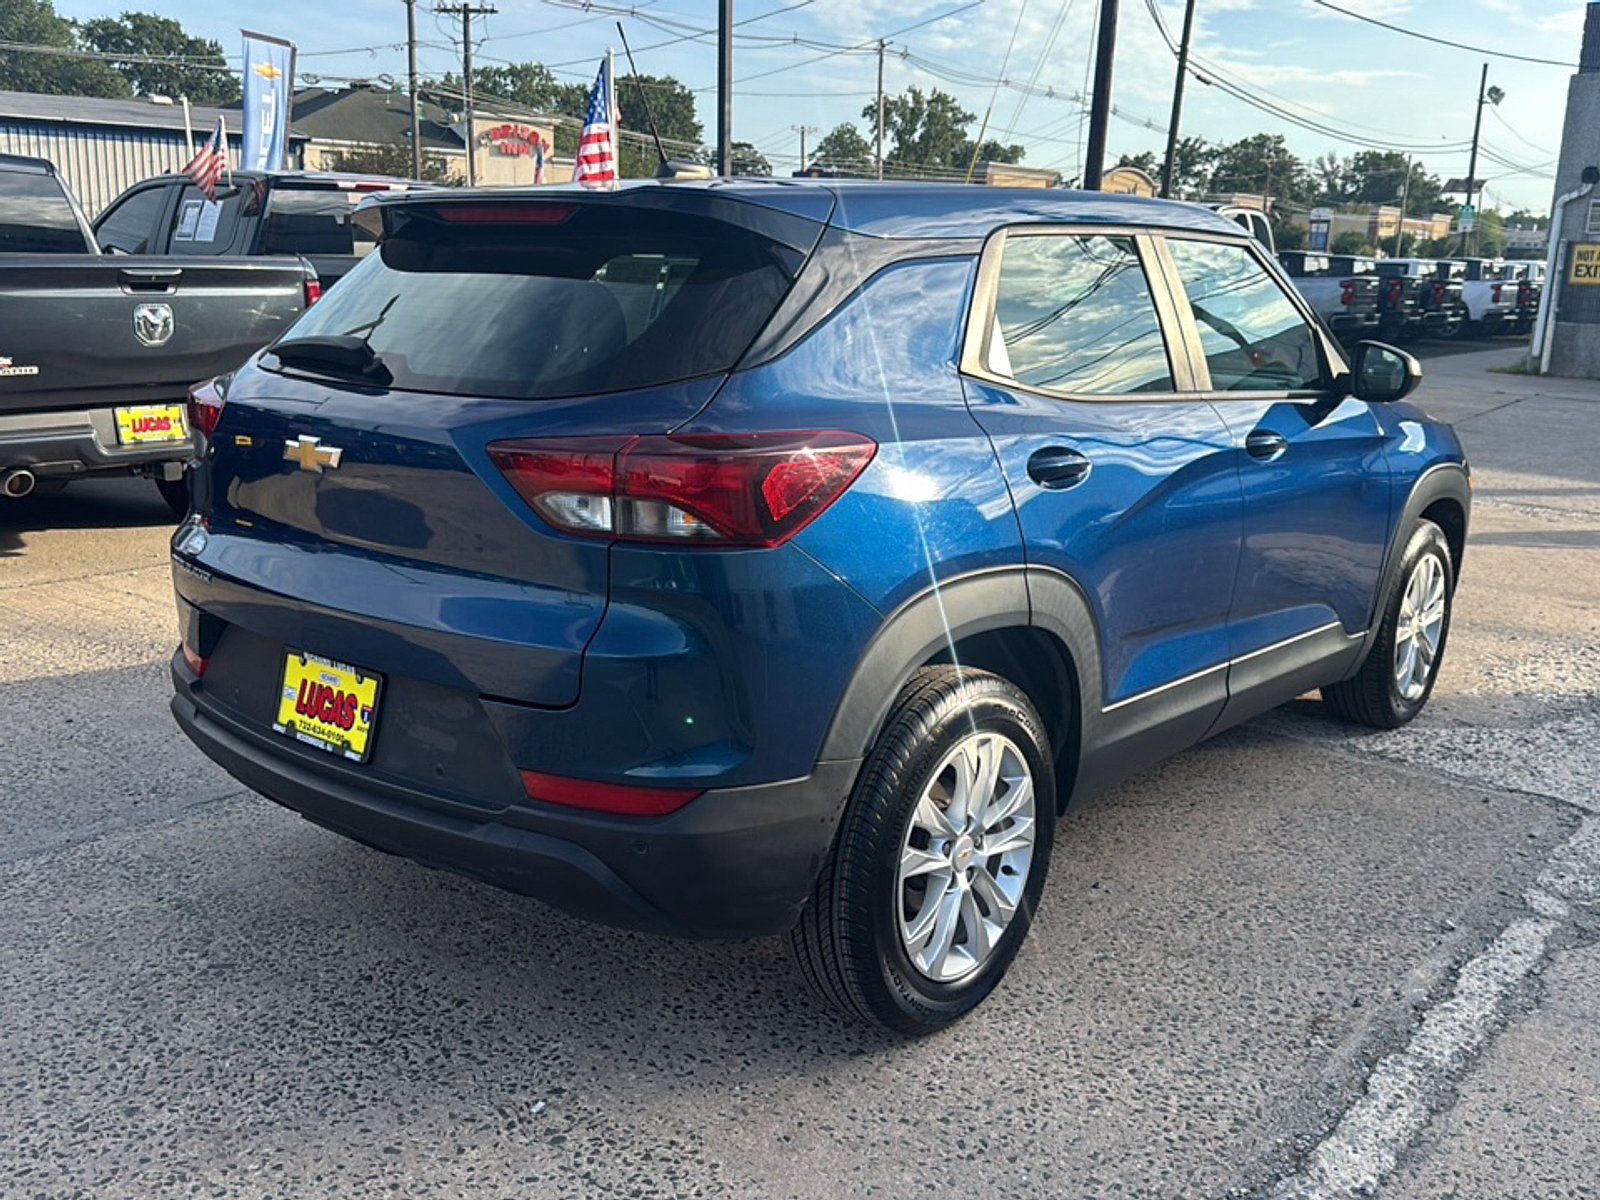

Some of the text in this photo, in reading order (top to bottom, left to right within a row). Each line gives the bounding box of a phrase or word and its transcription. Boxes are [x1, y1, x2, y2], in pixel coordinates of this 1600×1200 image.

[1575, 264, 1600, 277] EXI
[131, 416, 171, 433] LUCAS
[296, 678, 358, 731] LUCAS
